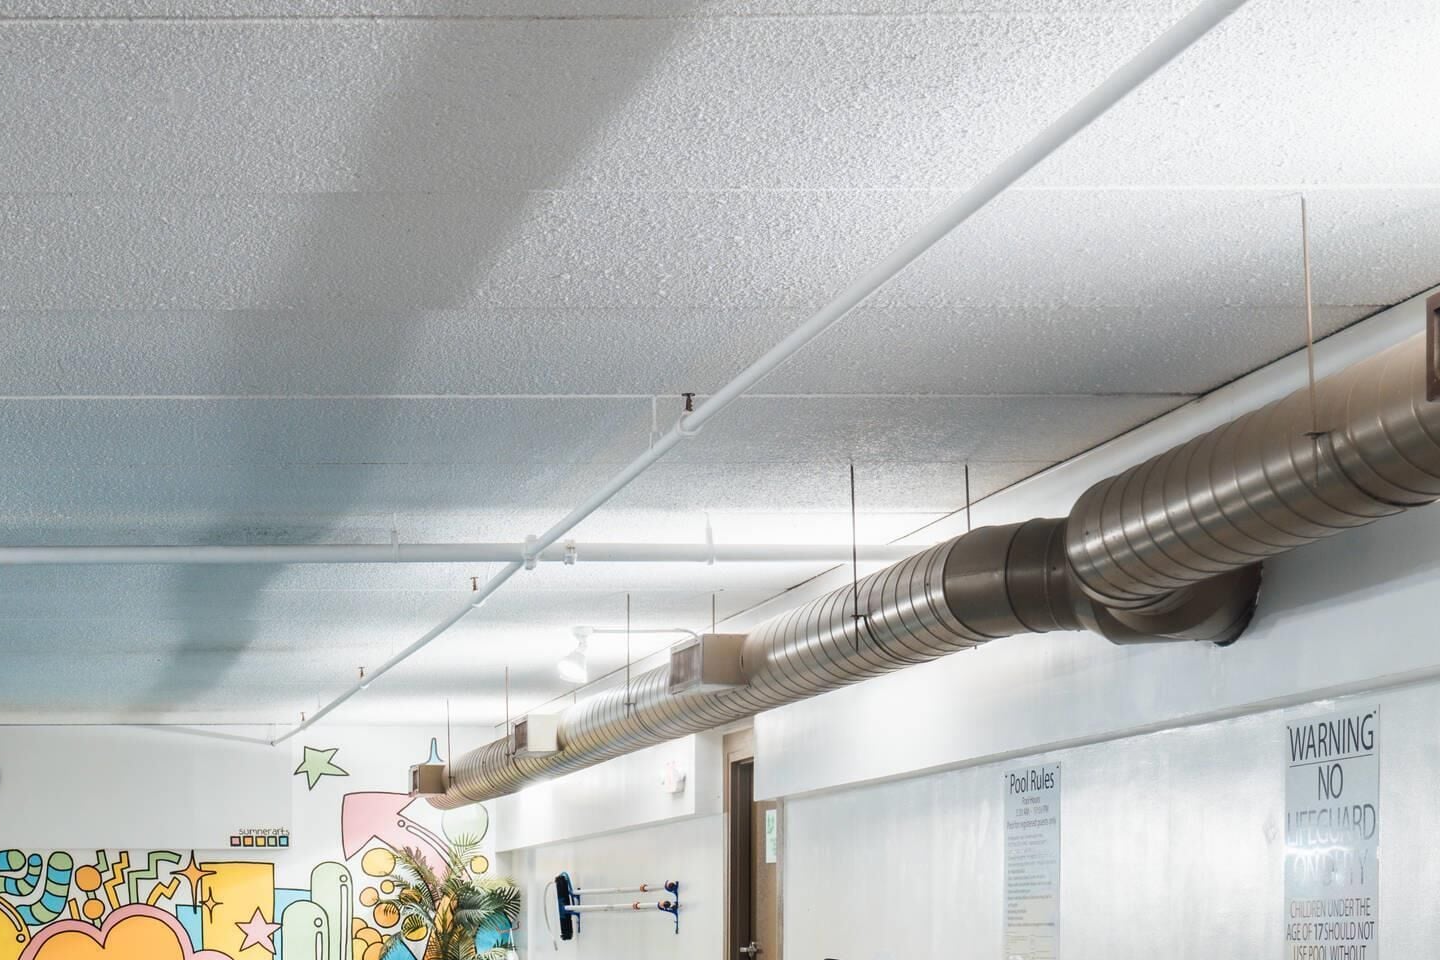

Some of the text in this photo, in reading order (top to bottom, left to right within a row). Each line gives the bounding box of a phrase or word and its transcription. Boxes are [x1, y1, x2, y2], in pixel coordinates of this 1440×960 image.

[1289, 713, 1374, 762] WARNING
[1010, 768, 1054, 794] Pool Rules
[1317, 762, 1344, 801] NO
[1287, 804, 1376, 846] LIFEGUARD
[1291, 898, 1370, 918] CHILDREN UNDER THE
[1286, 921, 1374, 940] AGE OF 17 SHOULD NOT
